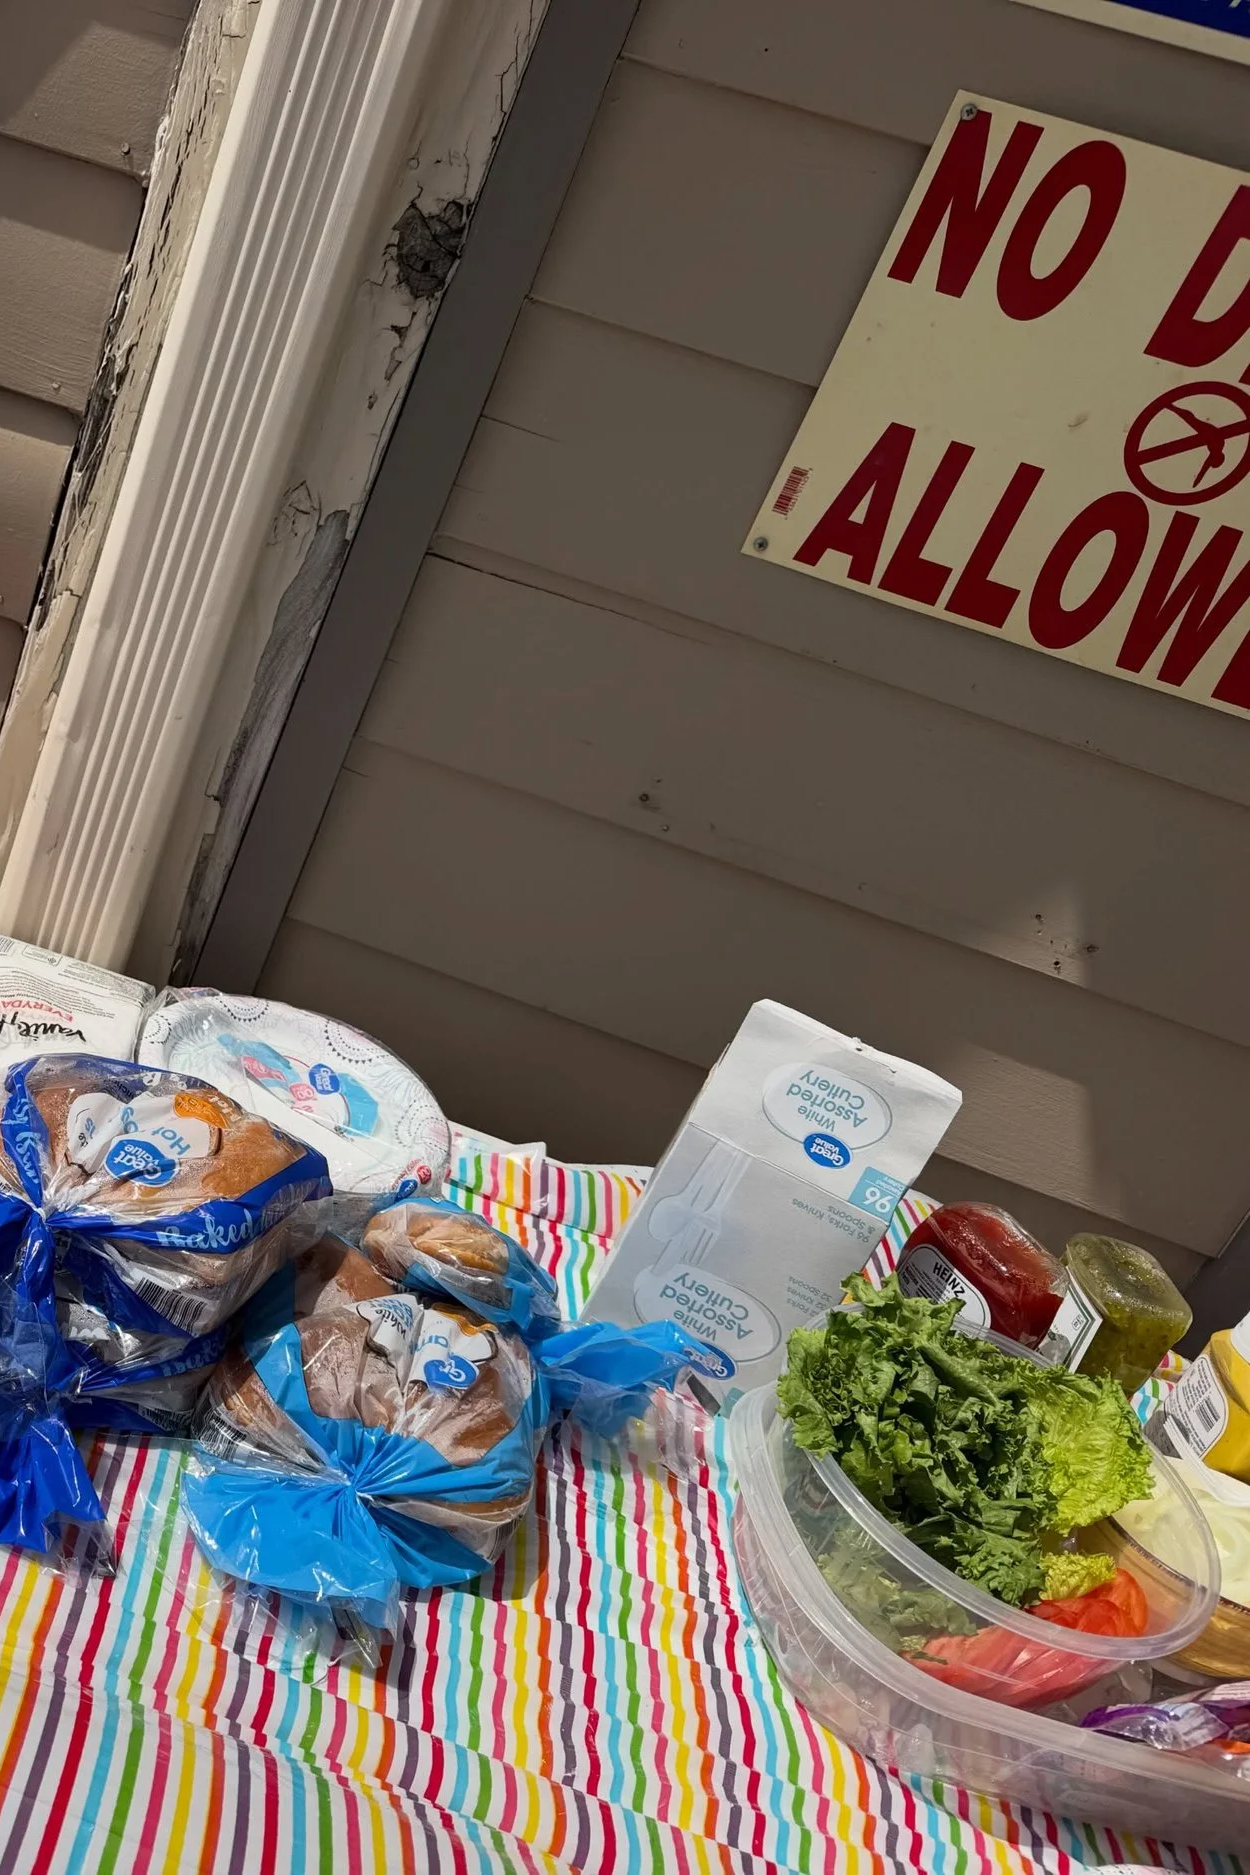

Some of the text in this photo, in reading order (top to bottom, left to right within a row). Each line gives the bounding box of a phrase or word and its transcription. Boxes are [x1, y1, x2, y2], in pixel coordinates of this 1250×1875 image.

[887, 109, 1250, 386] NO D
[799, 1069, 865, 1110] Cutlery
[786, 1083, 868, 1128] Assorted
[797, 1105, 836, 1132] White
[810, 1142, 844, 1166] Great
[814, 1137, 840, 1154] Value
[113, 1150, 162, 1180] Great
[791, 1198, 825, 1221] Knives
[863, 1187, 893, 1213] 96
[828, 1205, 867, 1230] Spoons
[857, 1231, 870, 1243] 96
[933, 1262, 966, 1297] HEINZ
[673, 1272, 749, 1321] Cutlery
[659, 1284, 754, 1340] Assorted
[673, 1310, 717, 1341] White
